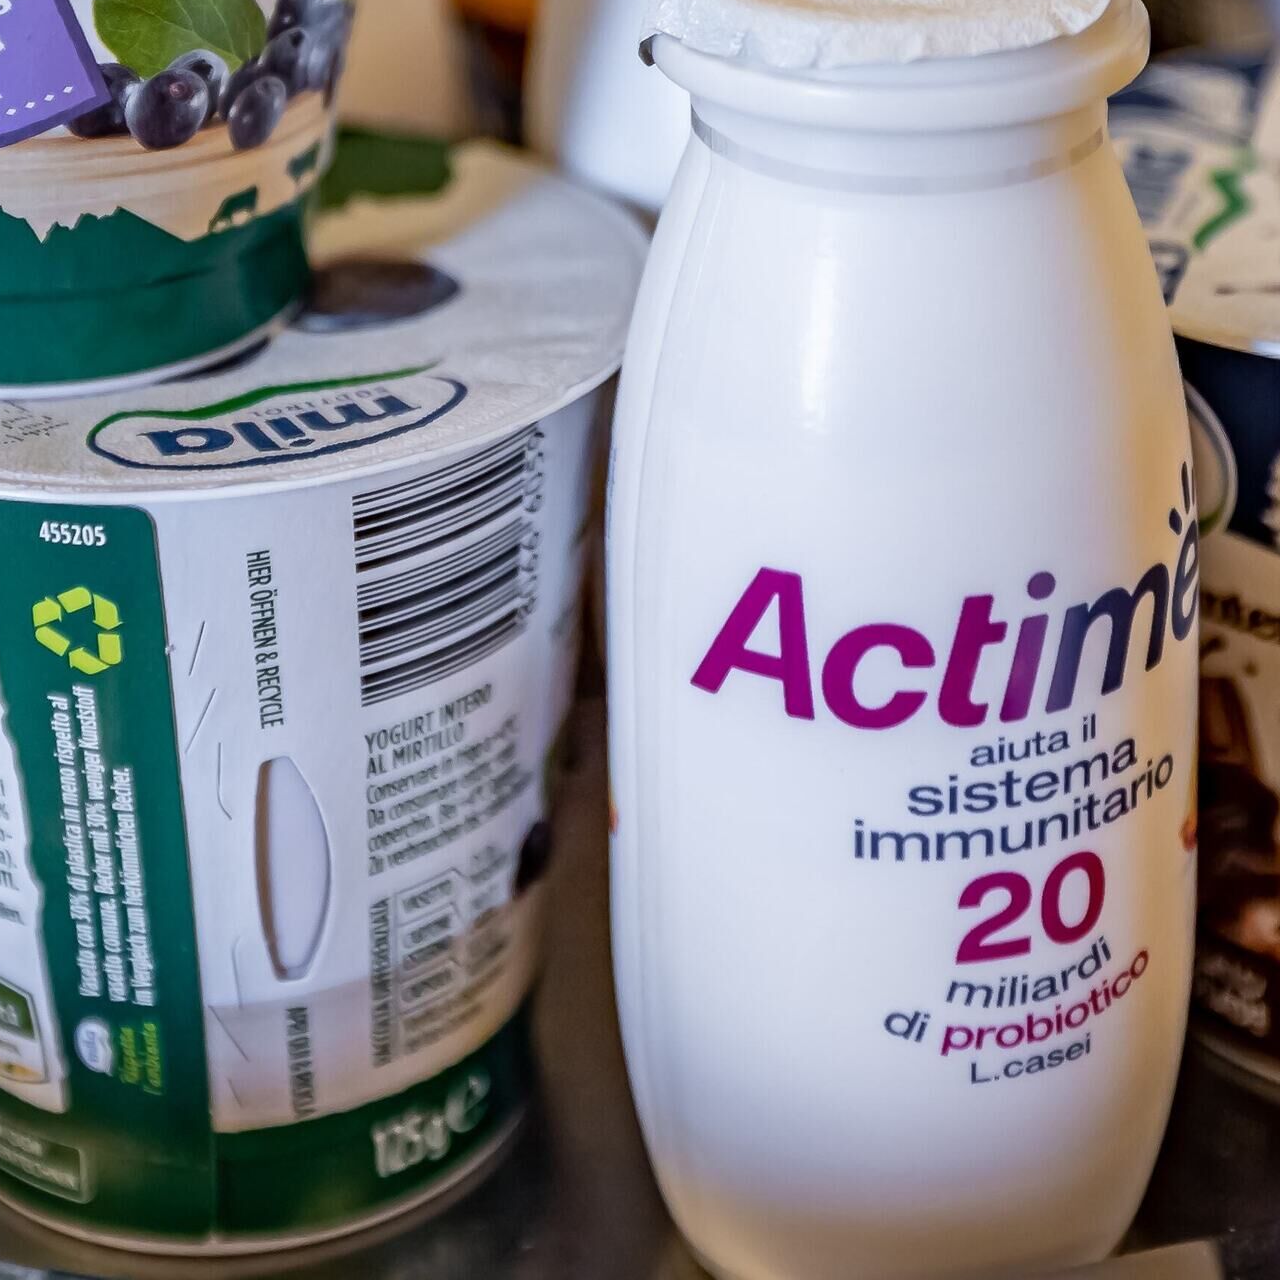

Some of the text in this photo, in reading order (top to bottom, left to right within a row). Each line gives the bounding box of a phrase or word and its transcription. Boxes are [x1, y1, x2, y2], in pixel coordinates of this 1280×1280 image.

[137, 392, 422, 457] mila
[39, 520, 107, 547] 455205
[246, 549, 284, 729] HIER ÖFFNEN & RECYCLE
[364, 683, 493, 754] YOGURT INTERO
[365, 753, 390, 779] AL
[391, 722, 464, 772] MIRTILLO
[970, 713, 1097, 768] aiuta il
[109, 766, 136, 812] Becher.
[853, 753, 1174, 862] immunitario
[907, 736, 1138, 817] sistema
[46, 695, 101, 998] Vasetto con 30% di plastica in meno rispetto al
[72, 684, 128, 1002] vasetto comune. Becher mit 30% weniger Kunststoff
[113, 814, 144, 906] herkömmlichen
[124, 907, 147, 934] zum
[955, 851, 1105, 966] 20
[124, 935, 156, 988] Vergleich
[945, 935, 1112, 1010] miliardi
[883, 1010, 931, 1044] di
[940, 950, 1150, 1057] probiotico
[970, 1033, 1092, 1085] L.casei
